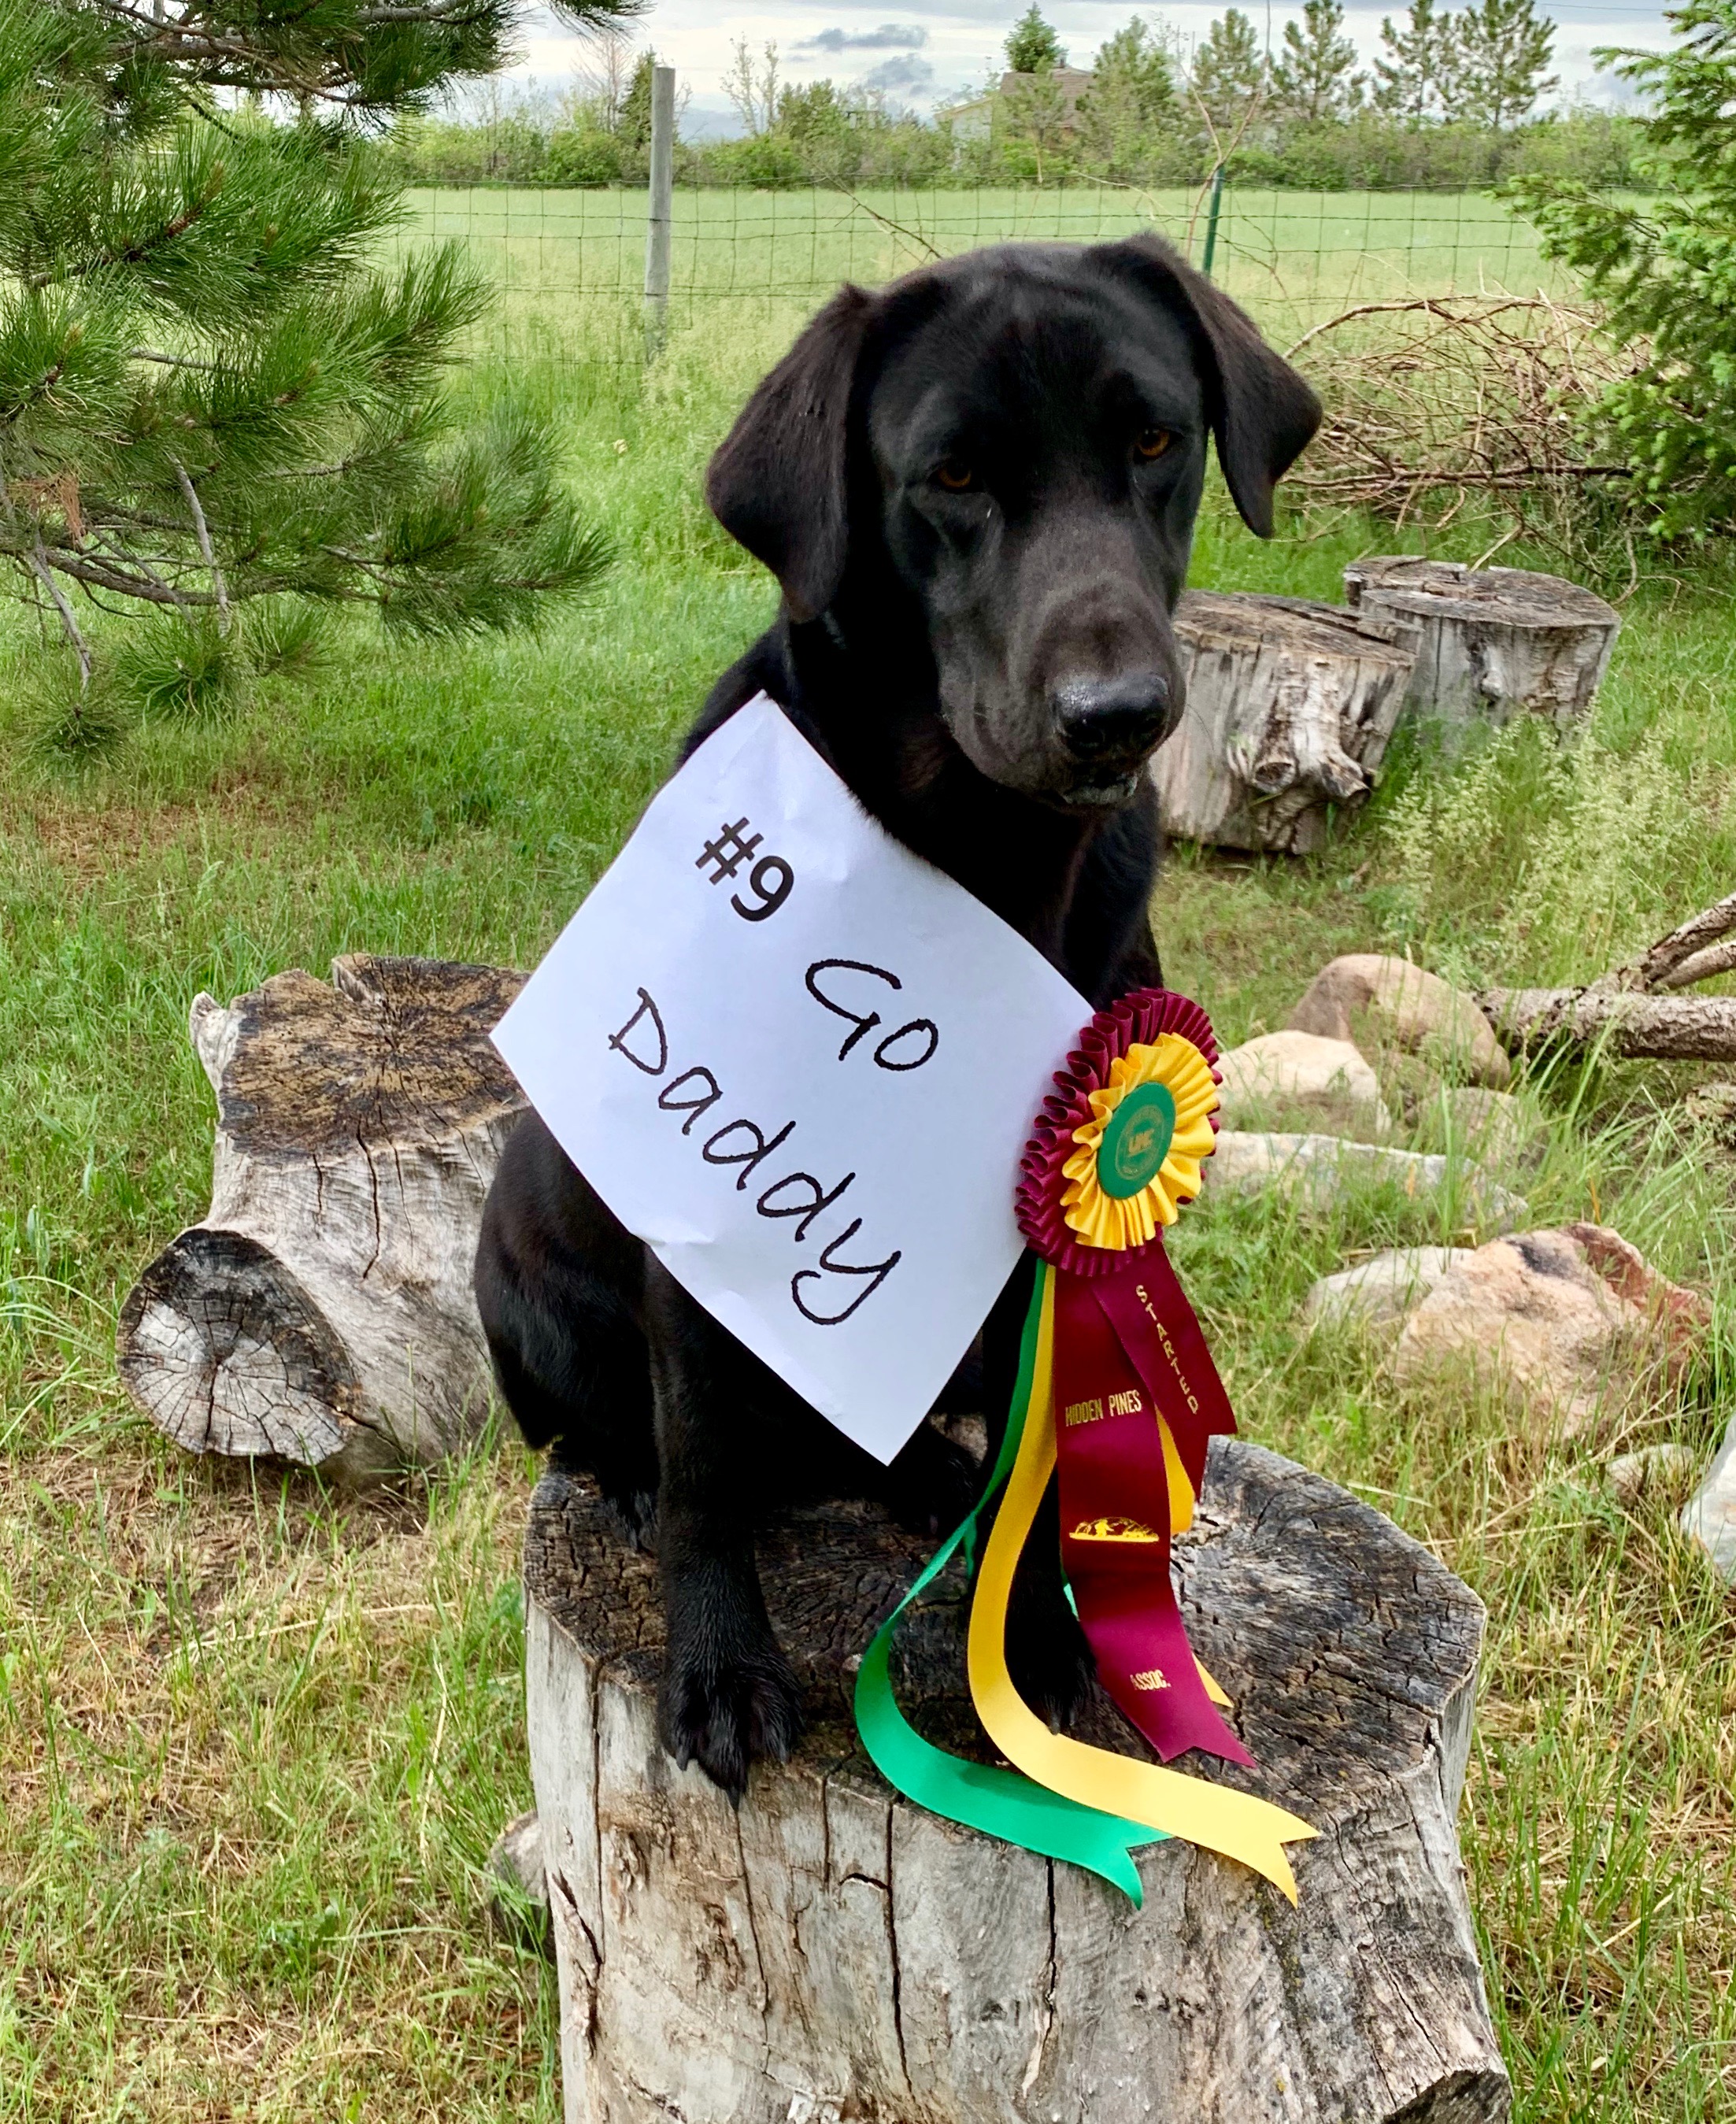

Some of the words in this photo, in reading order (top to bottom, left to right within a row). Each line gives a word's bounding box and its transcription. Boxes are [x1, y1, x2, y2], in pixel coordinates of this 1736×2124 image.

[695, 817, 794, 922] #9
[805, 958, 939, 1072] Go
[608, 986, 901, 1326] Daddy
[1135, 1284, 1199, 1415] STARTED
[1064, 1397, 1104, 1426] HIDDEN
[1108, 1389, 1142, 1416] PINES
[1129, 1669, 1172, 1690] ASSOC.
